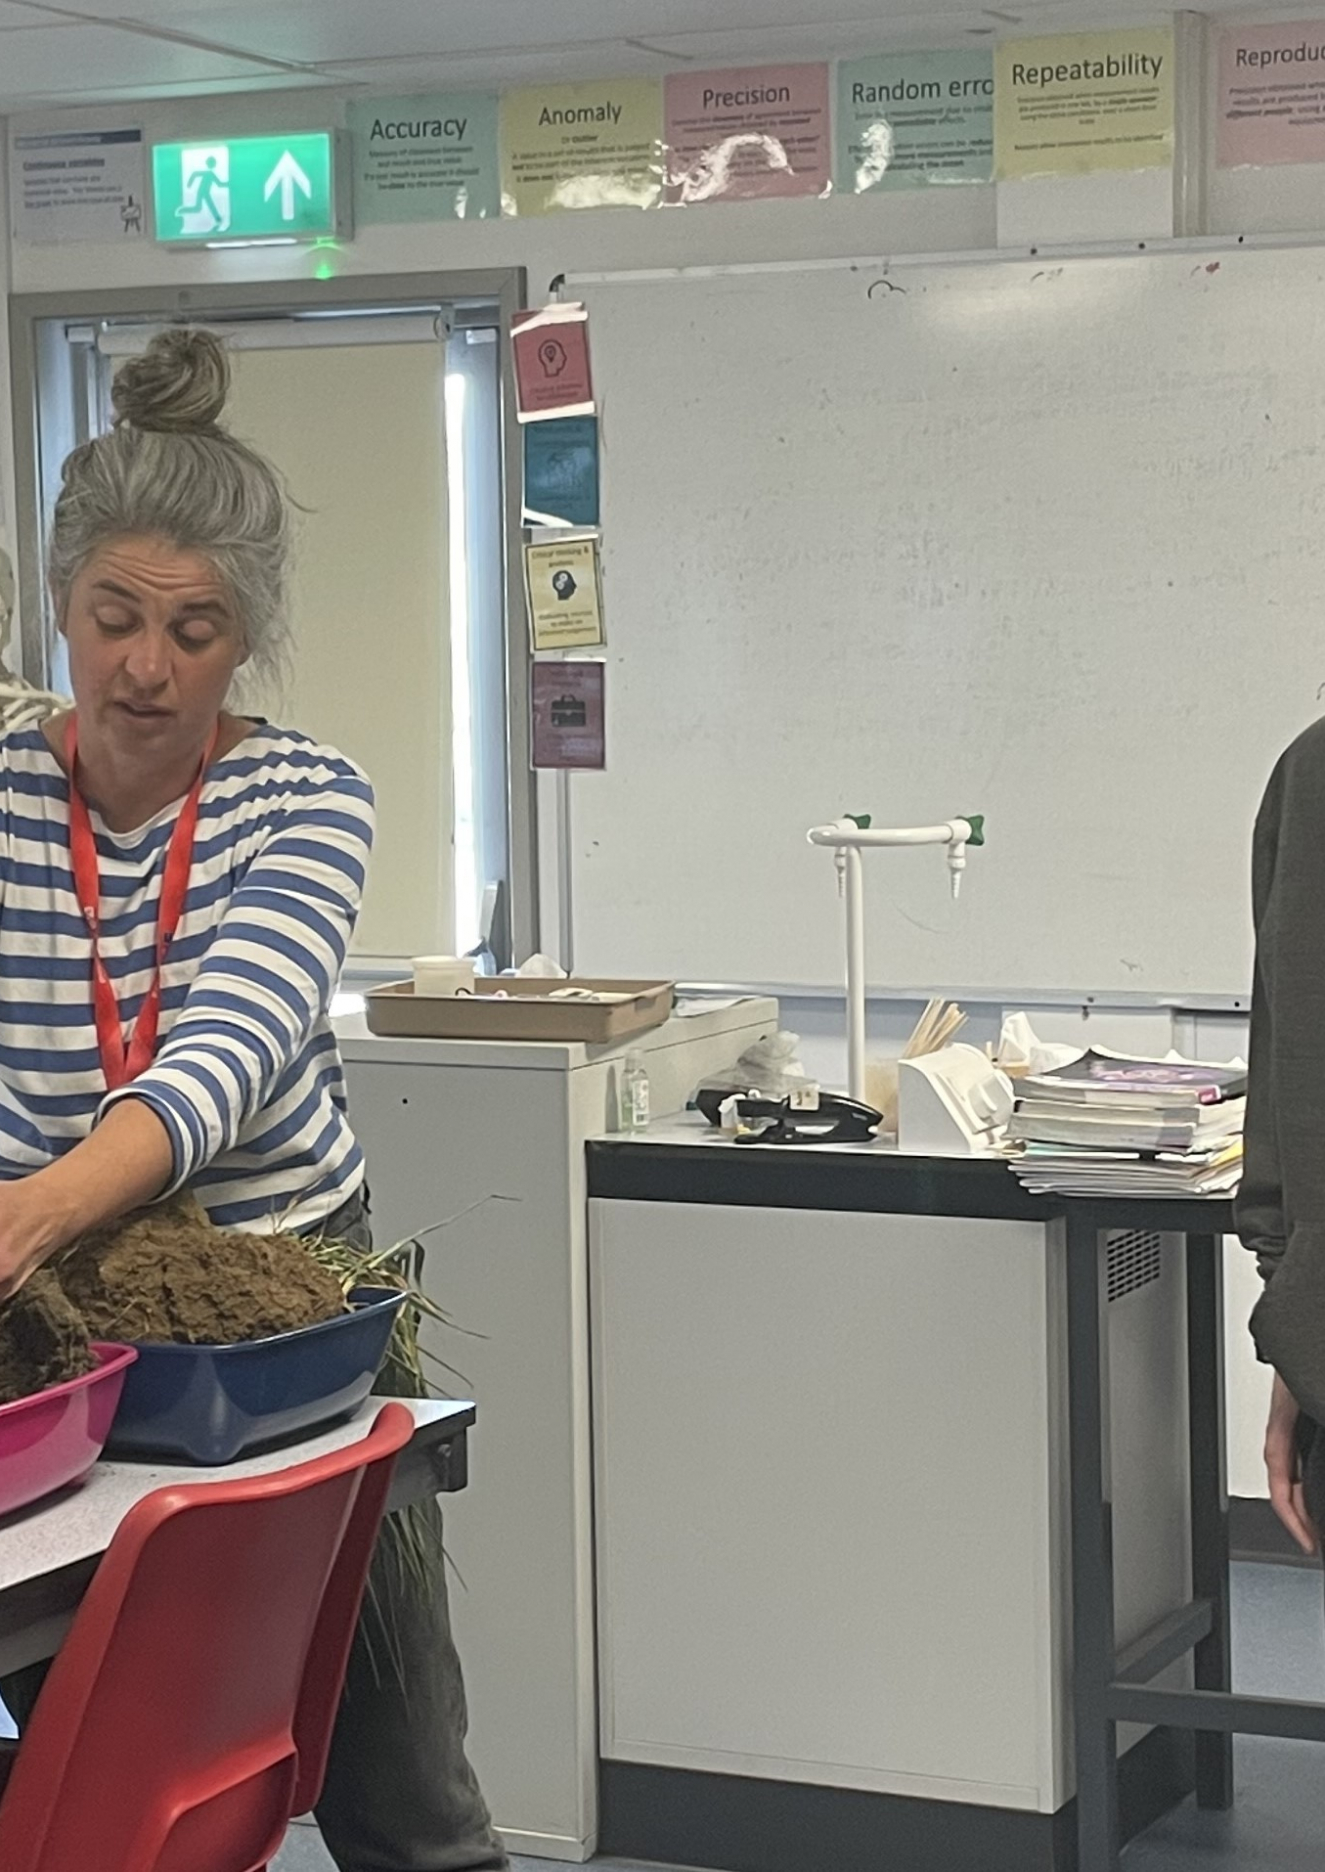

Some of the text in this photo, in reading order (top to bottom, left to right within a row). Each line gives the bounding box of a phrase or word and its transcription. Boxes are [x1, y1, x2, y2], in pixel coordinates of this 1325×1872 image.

[1012, 53, 1164, 88] Repeatability
[703, 86, 790, 110] Precision
[852, 78, 941, 104] Random
[538, 101, 622, 126] Anomaly
[370, 118, 468, 141] Accuracy
